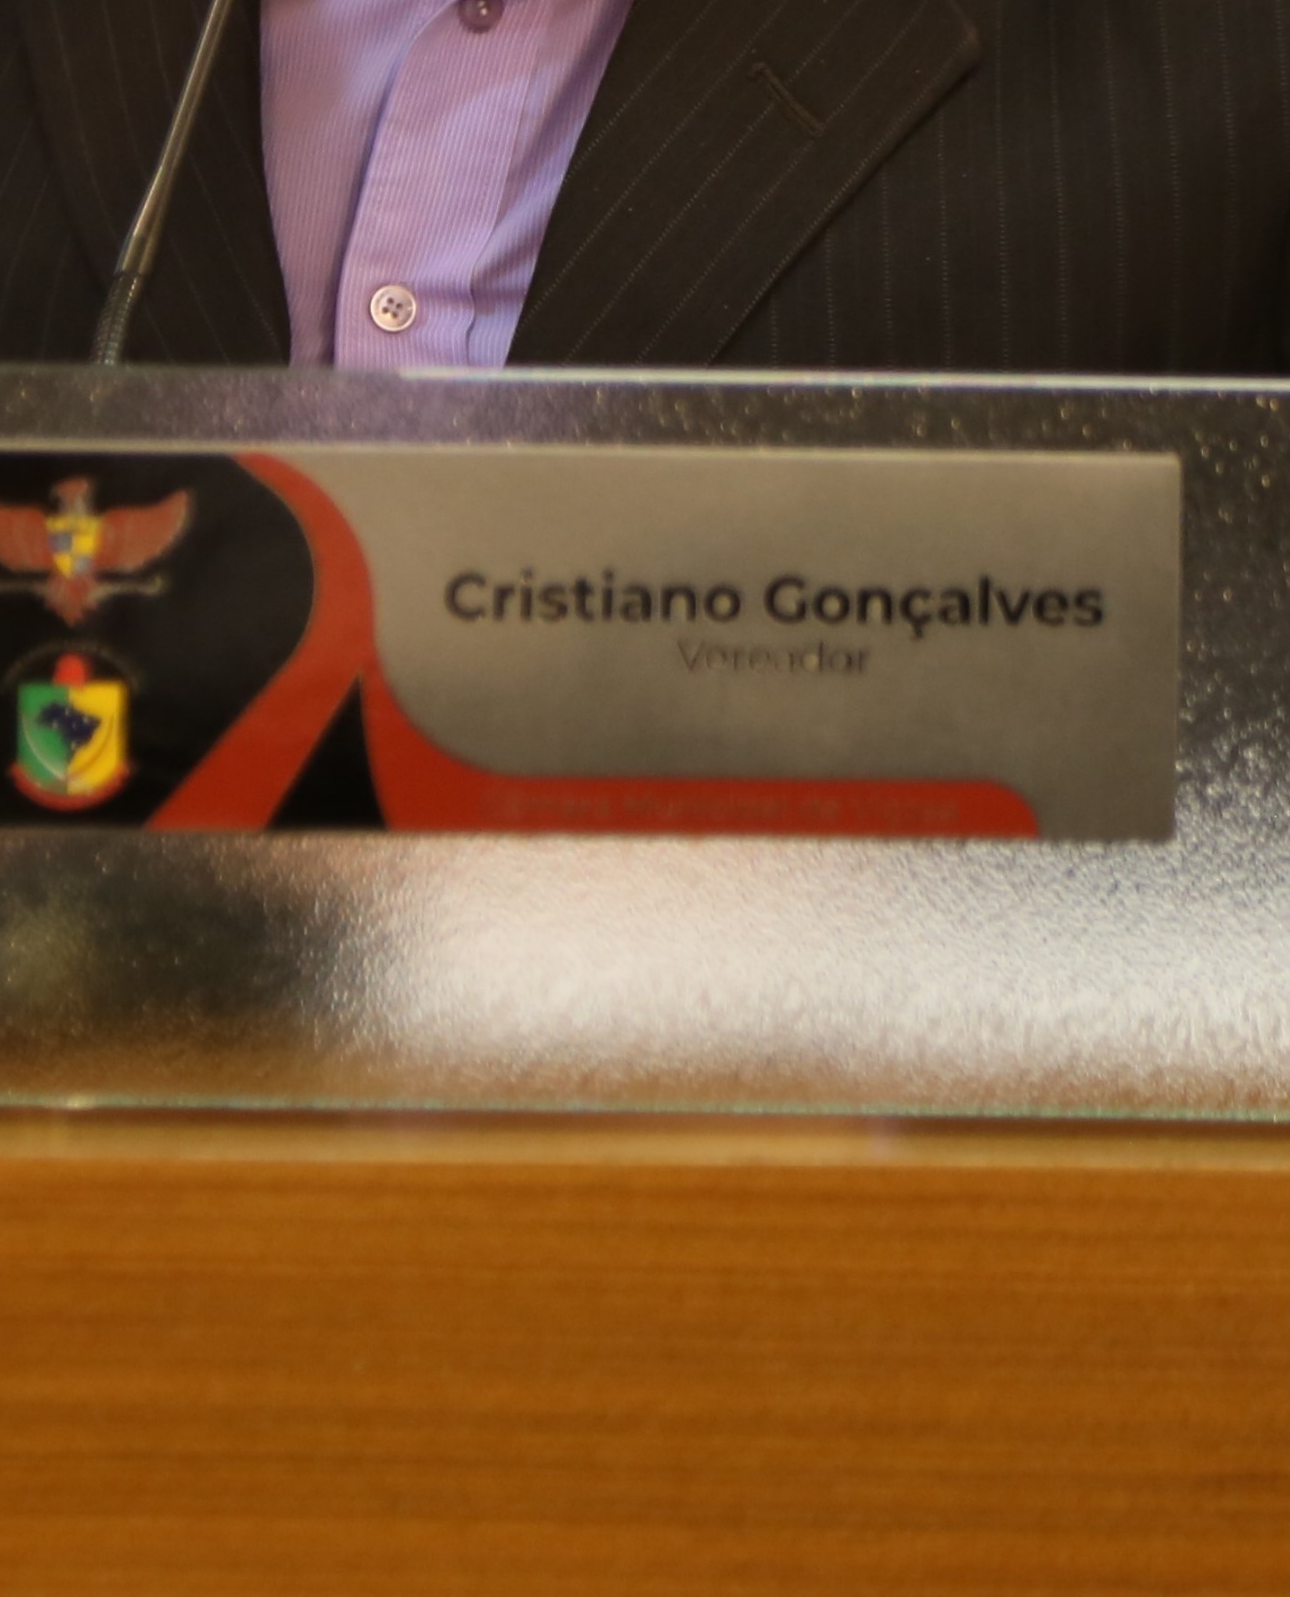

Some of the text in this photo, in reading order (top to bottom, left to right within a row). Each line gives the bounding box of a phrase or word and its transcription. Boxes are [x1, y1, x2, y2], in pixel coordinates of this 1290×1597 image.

[443, 568, 1104, 640] Cristiano Gonçalves
[676, 638, 870, 674] Vereador
